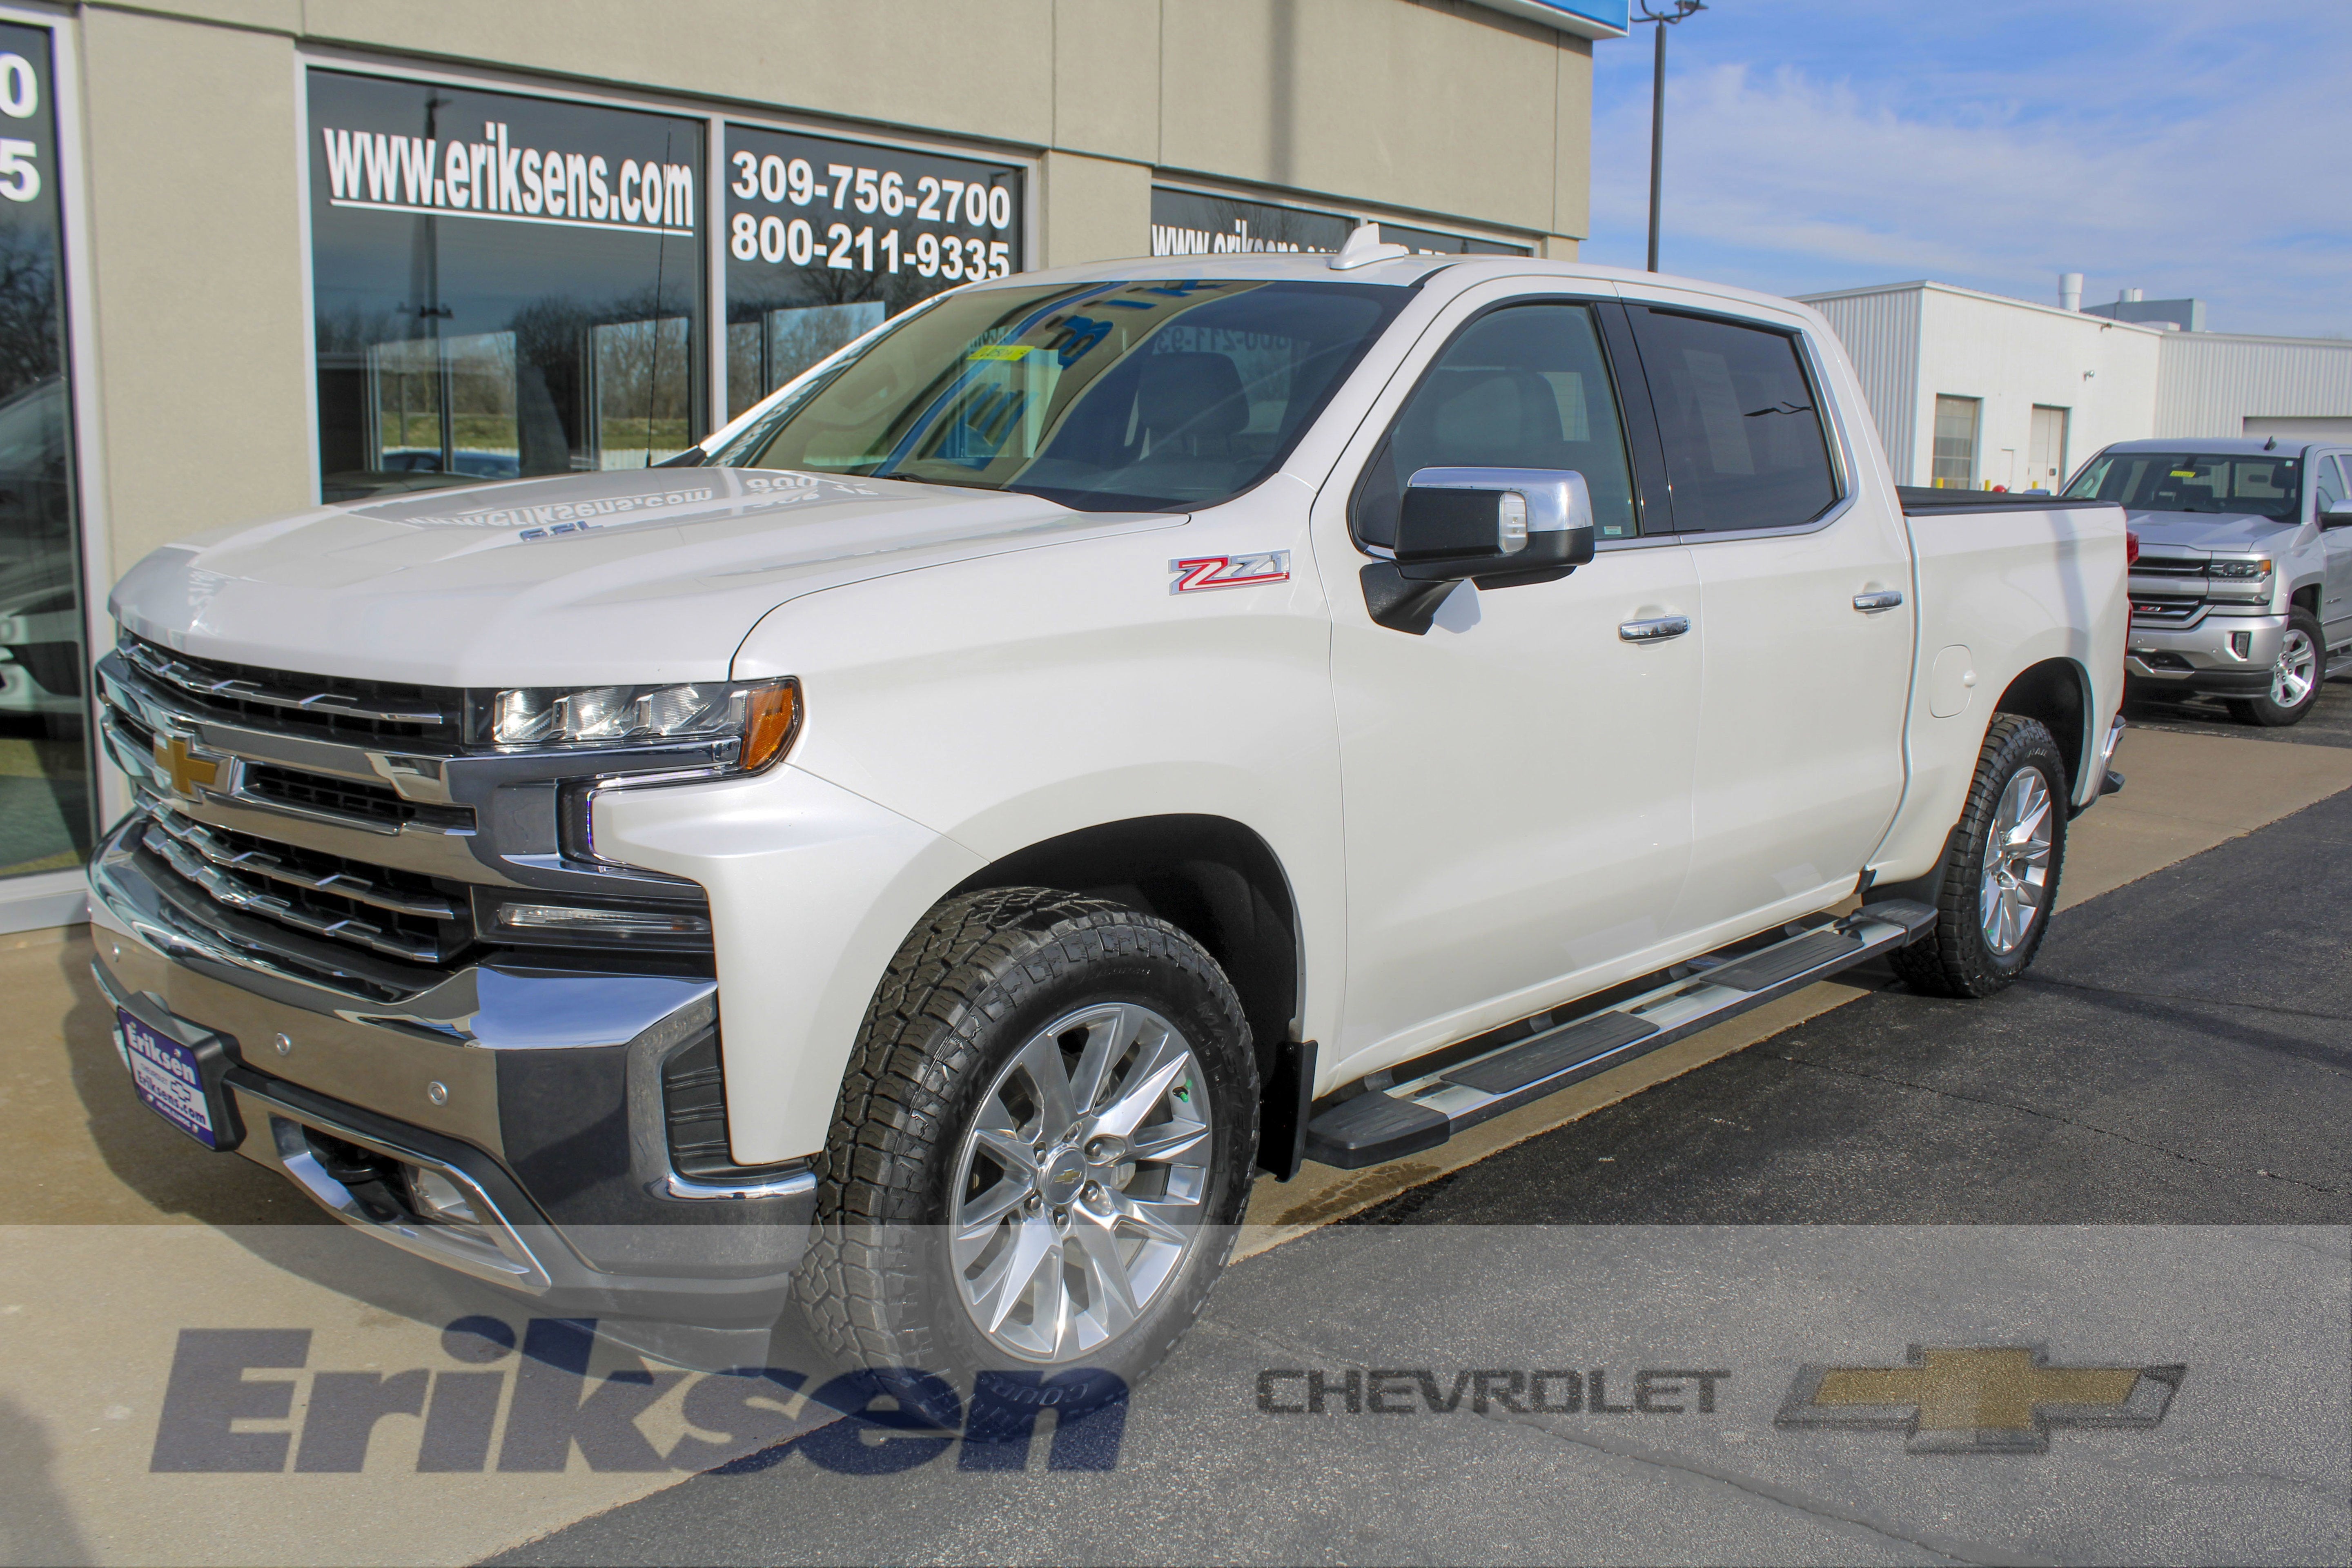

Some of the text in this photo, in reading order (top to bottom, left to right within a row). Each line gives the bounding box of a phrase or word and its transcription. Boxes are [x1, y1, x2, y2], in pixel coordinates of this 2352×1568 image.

[323, 121, 694, 227] www.eriksens.com
[732, 150, 1011, 229] 309-756-2700
[731, 212, 1010, 281] 800-211-9335
[1168, 550, 1291, 596] Z71
[125, 1022, 196, 1085] Eriksen
